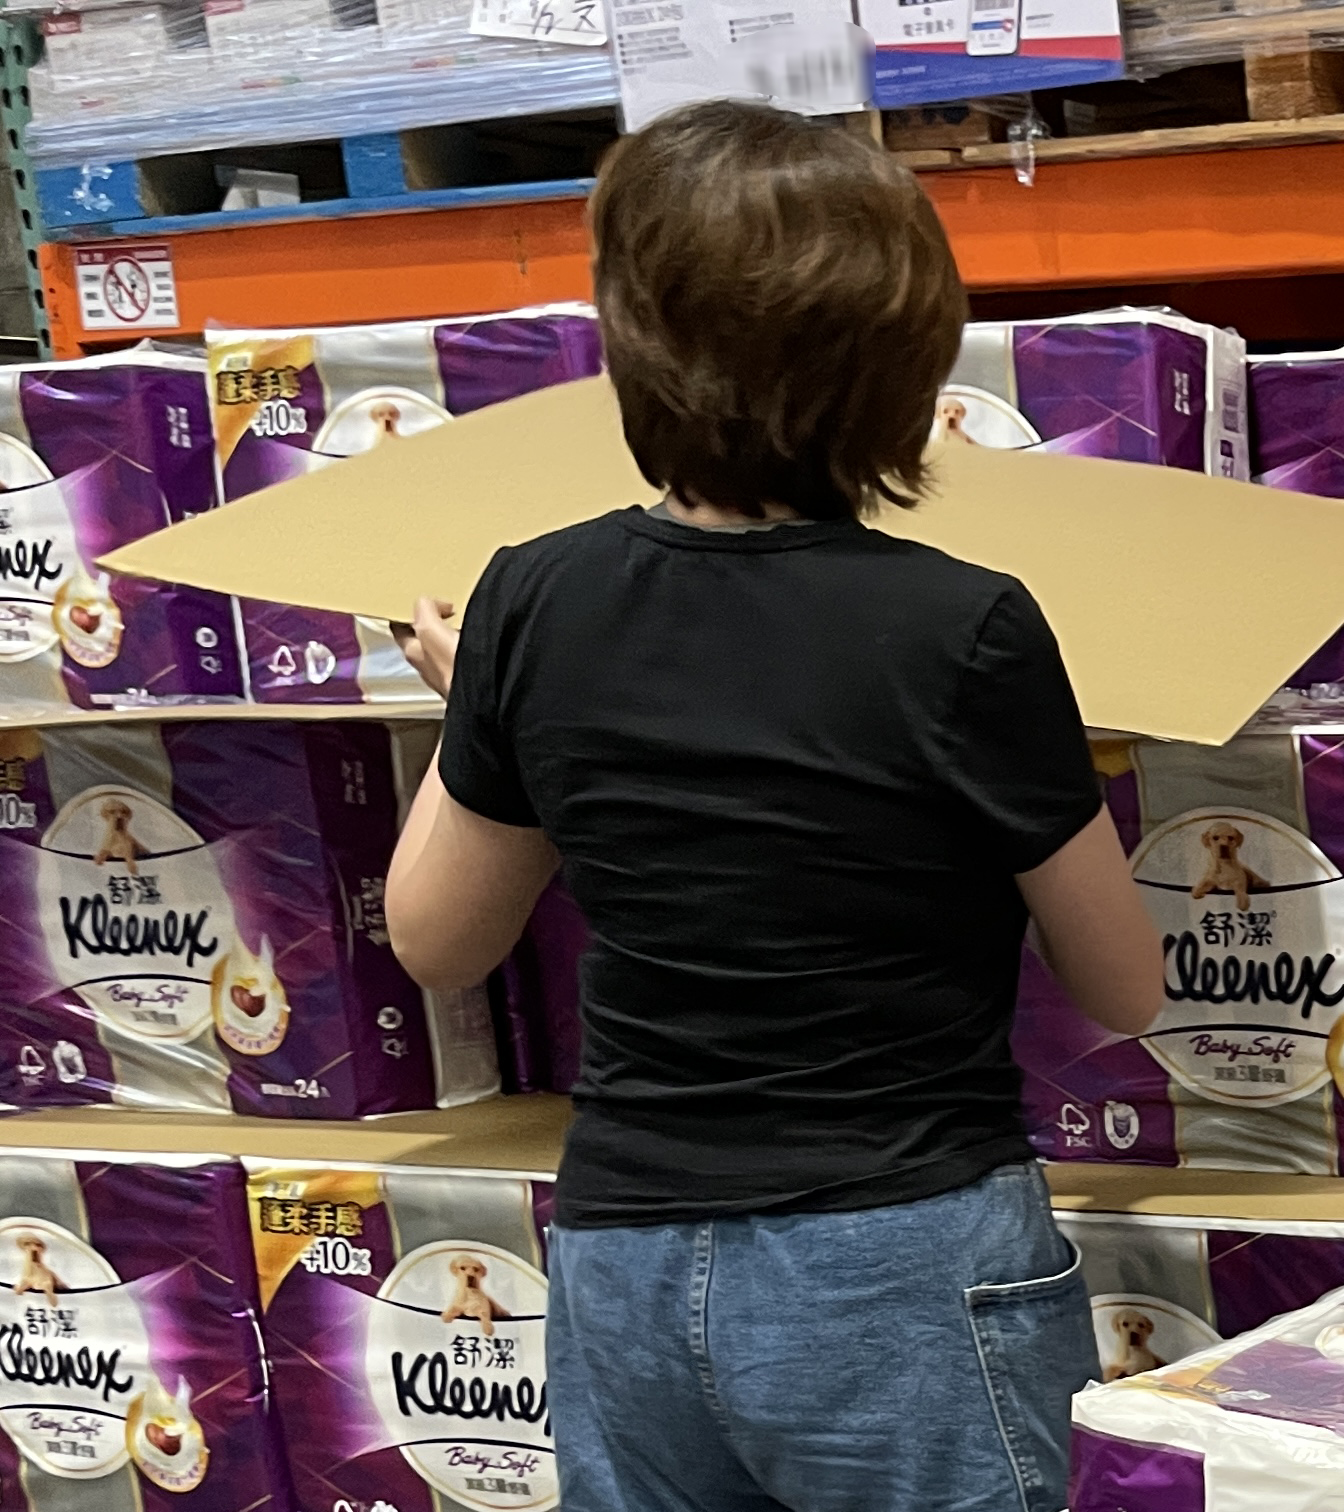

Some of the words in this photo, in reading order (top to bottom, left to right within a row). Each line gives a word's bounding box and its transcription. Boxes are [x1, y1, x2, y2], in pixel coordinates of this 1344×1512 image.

[59, 895, 218, 968] Kleenex
[1200, 910, 1273, 948] 舒潔
[1190, 1034, 1241, 1061] Baby
[1244, 1036, 1296, 1063] Soft
[304, 1237, 371, 1275] +10%
[24, 1307, 79, 1339] 舒潔
[0, 1322, 135, 1403] leenex
[451, 1334, 516, 1369] 舒潔
[445, 1447, 492, 1474] Baby
[496, 1451, 541, 1478] Soft
